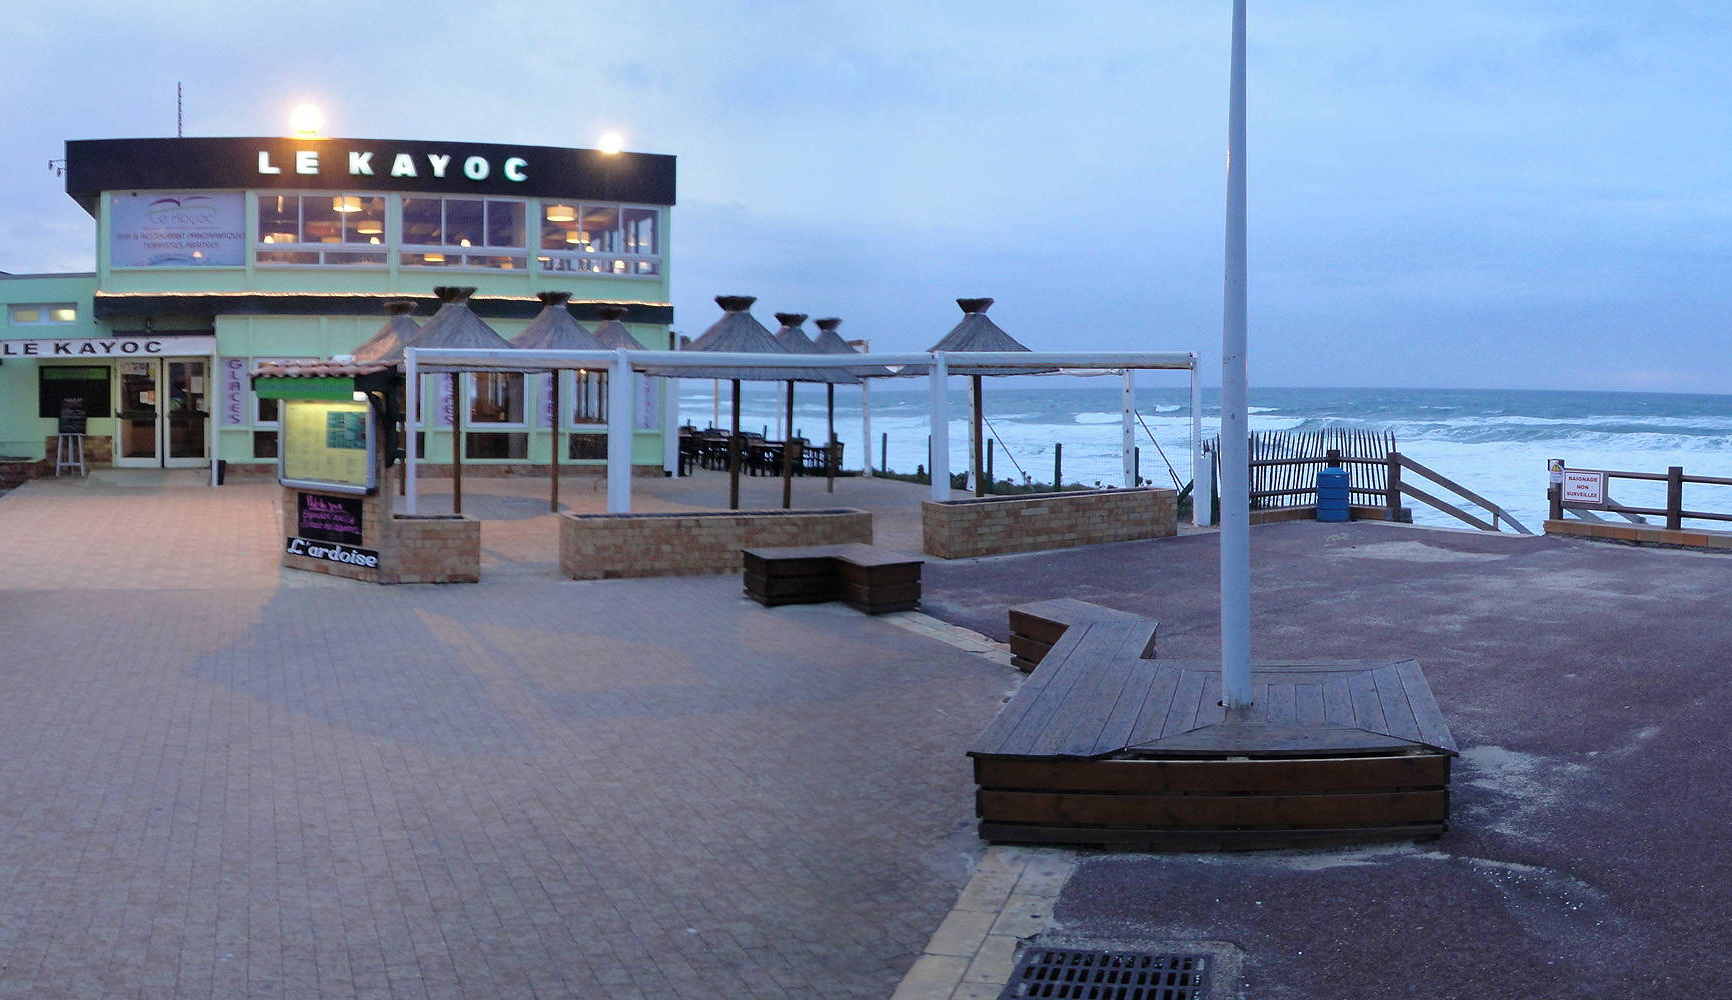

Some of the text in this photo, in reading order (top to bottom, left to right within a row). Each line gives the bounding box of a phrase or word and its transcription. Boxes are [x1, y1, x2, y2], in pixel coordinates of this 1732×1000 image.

[258, 151, 529, 182] LE KAYOC
[149, 211, 212, 225] Le Kayoc
[117, 233, 131, 241] BAR
[140, 232, 185, 240] RESTAURANT
[2, 341, 162, 355] LE KAYOC
[229, 359, 242, 425] GLACES
[287, 538, 379, 568] L'ardoise
